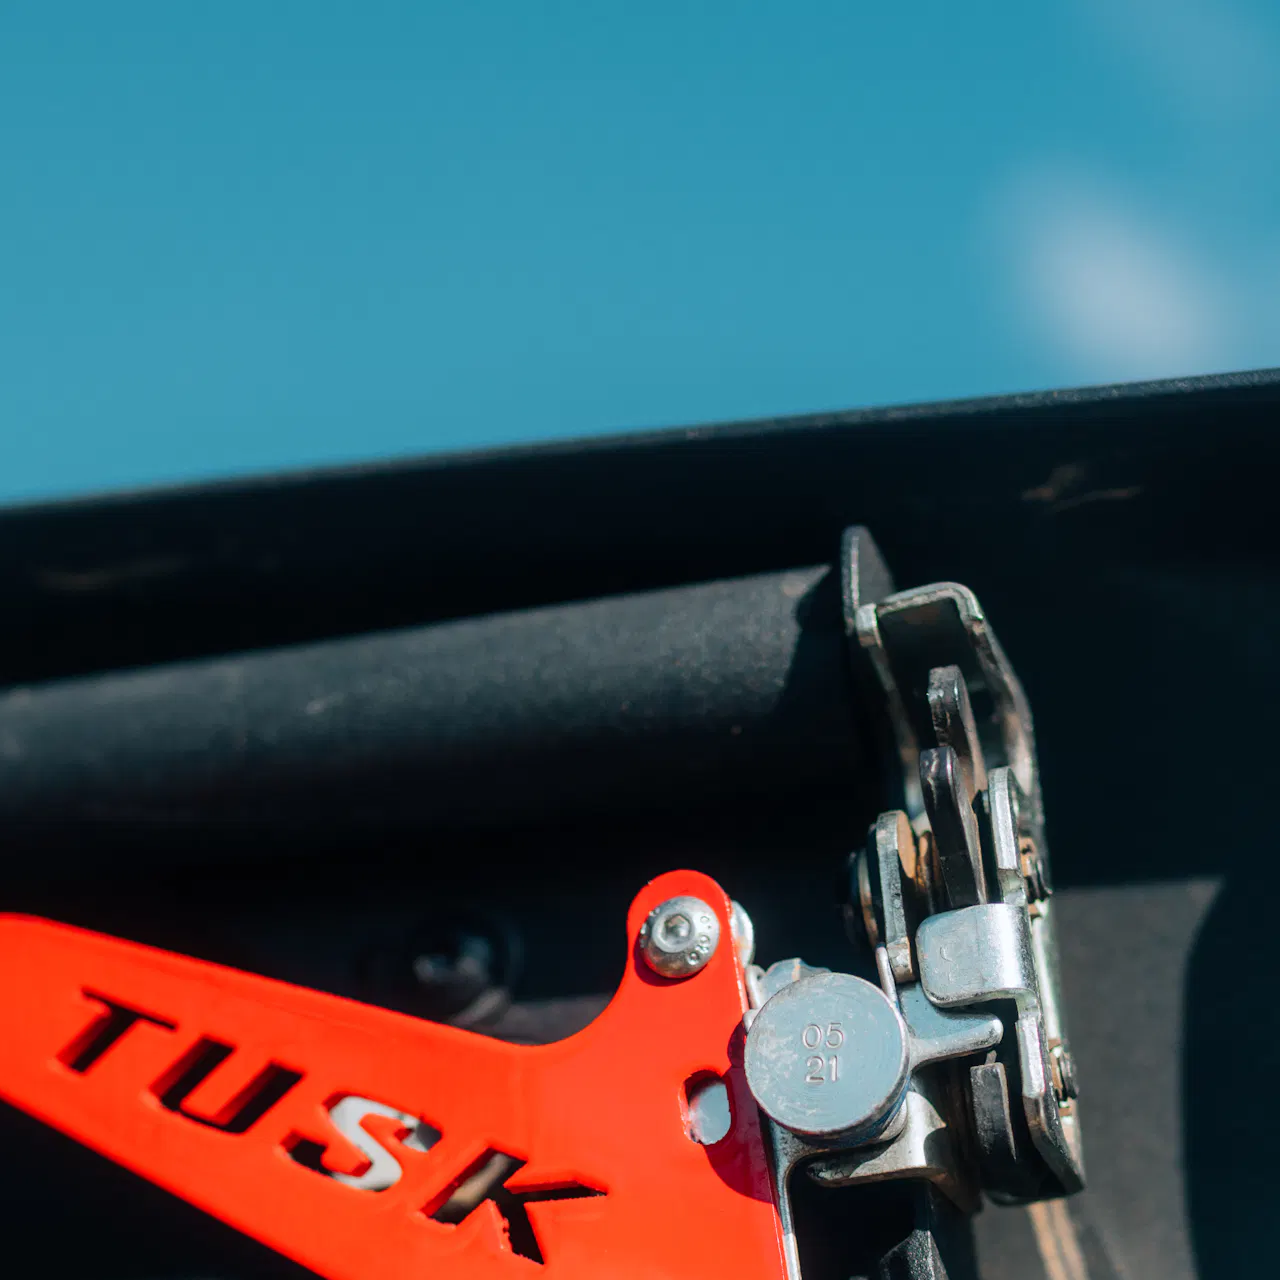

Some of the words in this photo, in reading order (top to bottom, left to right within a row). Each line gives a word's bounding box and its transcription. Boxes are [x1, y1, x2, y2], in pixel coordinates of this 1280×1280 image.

[801, 1022, 845, 1049] 05
[805, 1055, 839, 1084] 21
[53, 986, 608, 1265] TUSK
